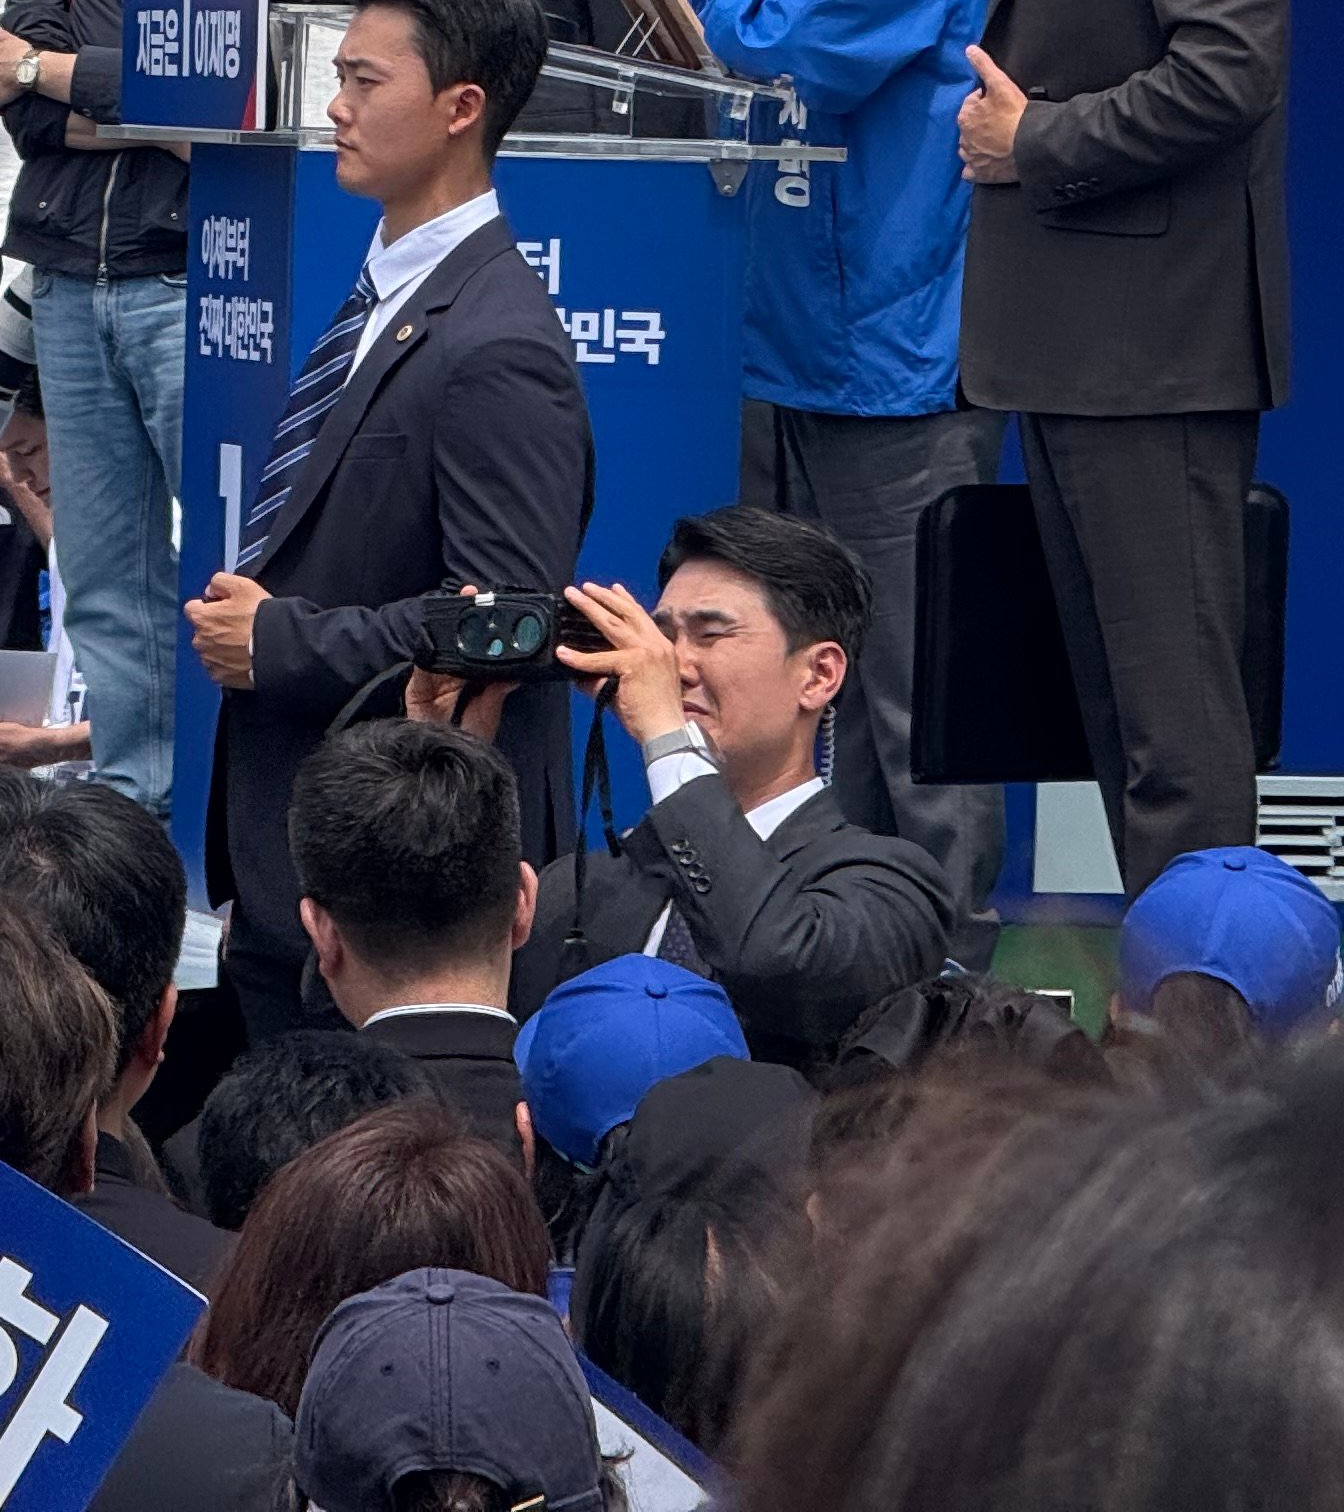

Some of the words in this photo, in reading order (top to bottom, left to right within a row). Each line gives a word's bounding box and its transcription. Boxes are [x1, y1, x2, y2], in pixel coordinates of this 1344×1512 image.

[136, 9, 179, 76] 지금은
[194, 9, 241, 79] 이재명
[201, 215, 250, 281] 이제부터
[199, 294, 224, 358] 진짜
[224, 296, 275, 364] 대한민국
[554, 308, 666, 366] 민국
